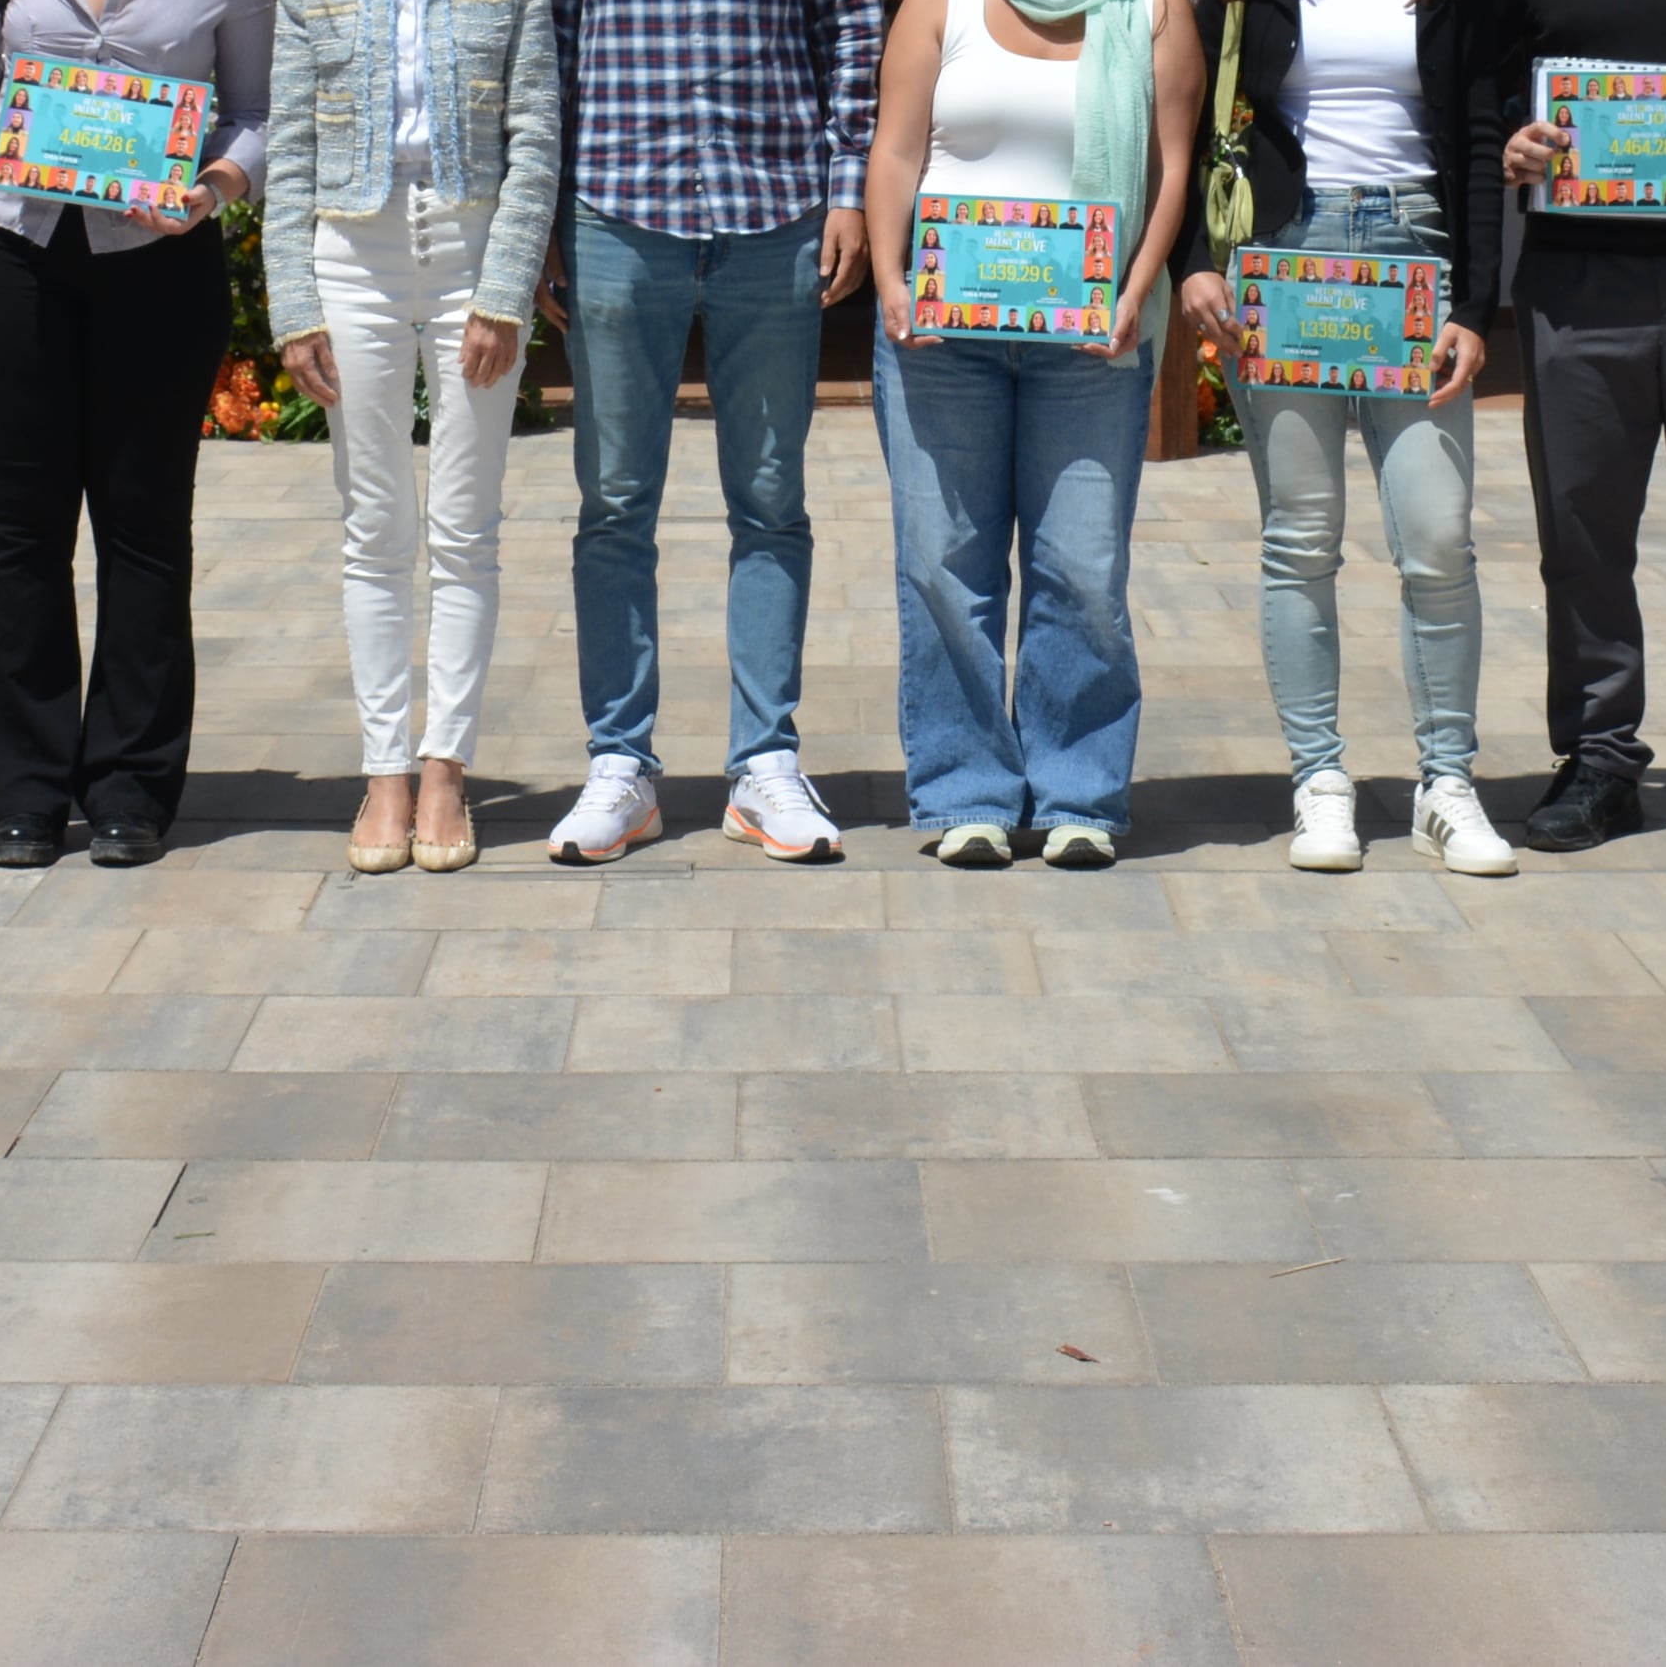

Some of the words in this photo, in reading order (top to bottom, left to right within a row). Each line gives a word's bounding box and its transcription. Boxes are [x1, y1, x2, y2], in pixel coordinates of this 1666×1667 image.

[99, 107, 135, 126] JOVE
[1013, 238, 1047, 253] JOVE
[1334, 295, 1368, 311] JOVE
